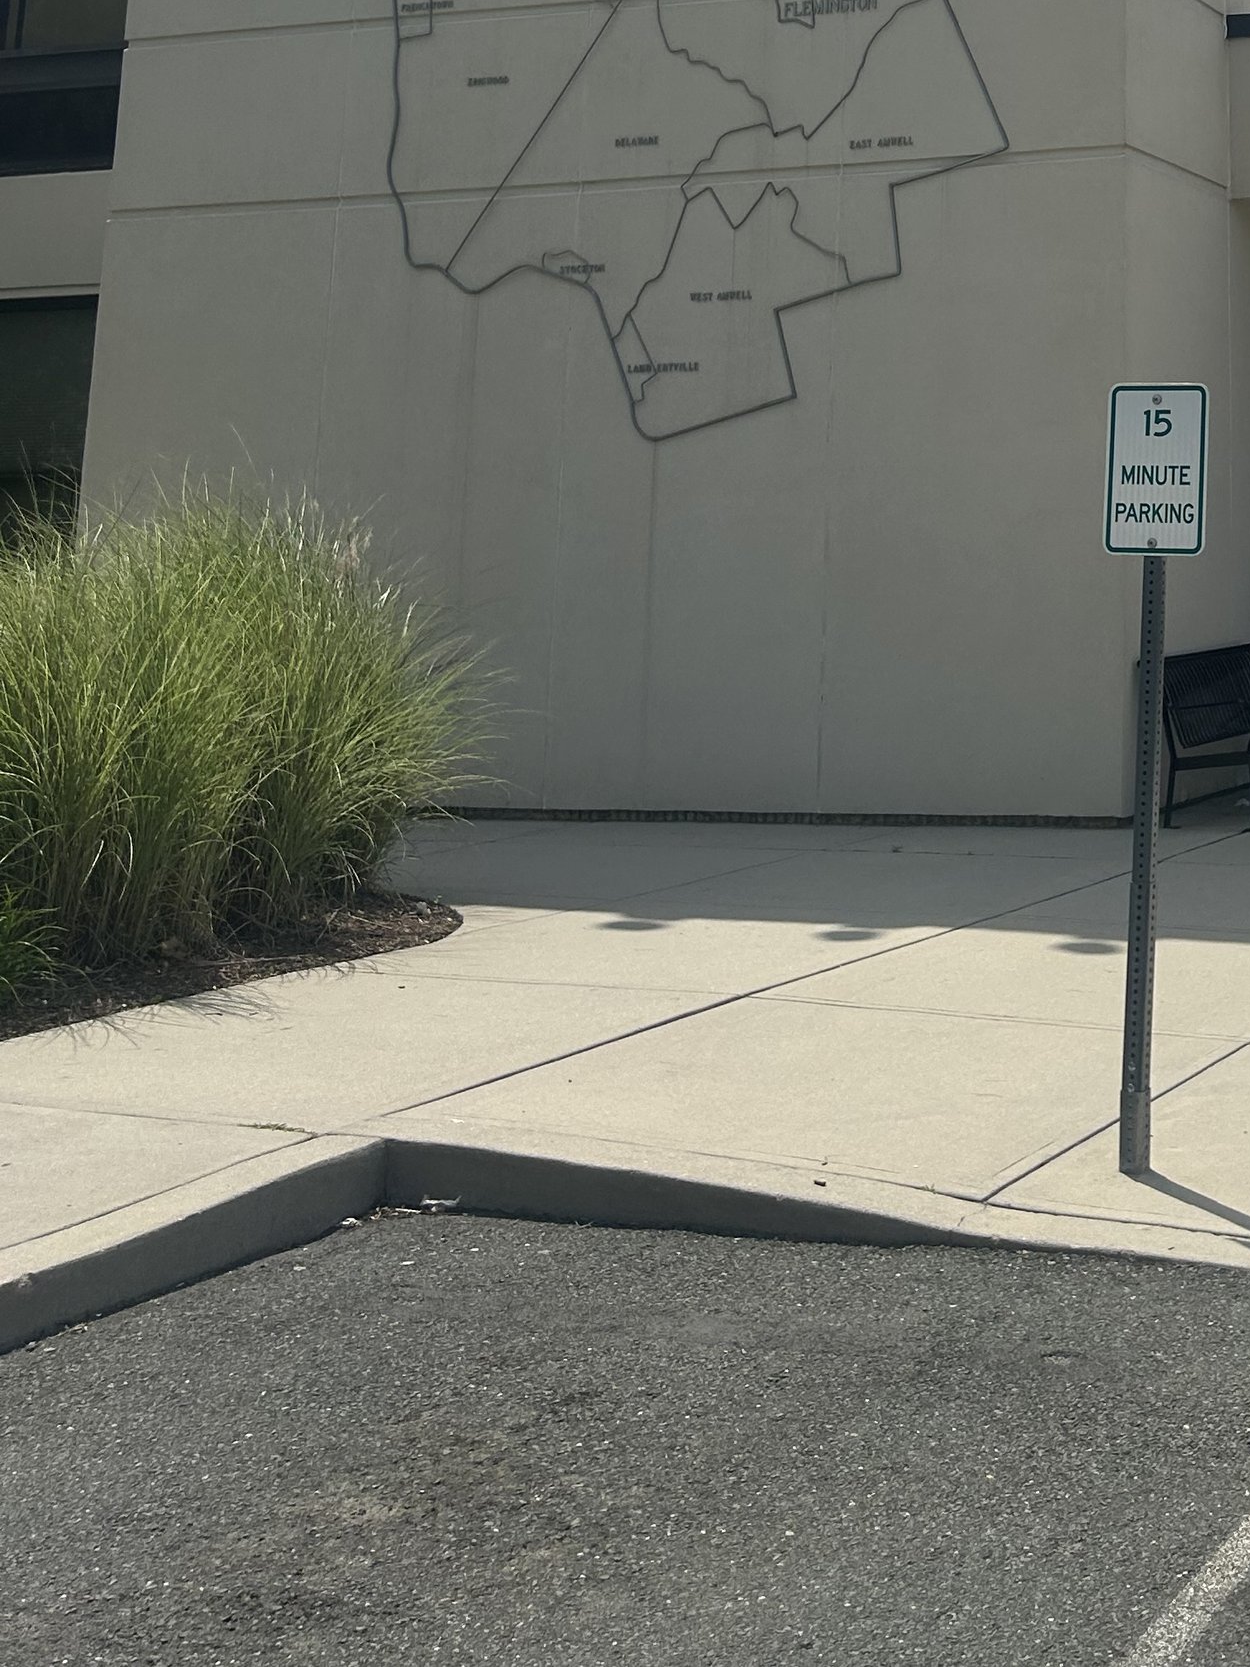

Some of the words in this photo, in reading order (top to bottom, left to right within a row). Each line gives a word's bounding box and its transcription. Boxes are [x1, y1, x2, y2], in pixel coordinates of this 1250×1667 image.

[848, 138, 872, 150] EAST
[690, 292, 714, 302] WEST
[1143, 409, 1172, 437] 15
[1121, 465, 1191, 485] MINUTE
[1115, 503, 1194, 524] PARKING
